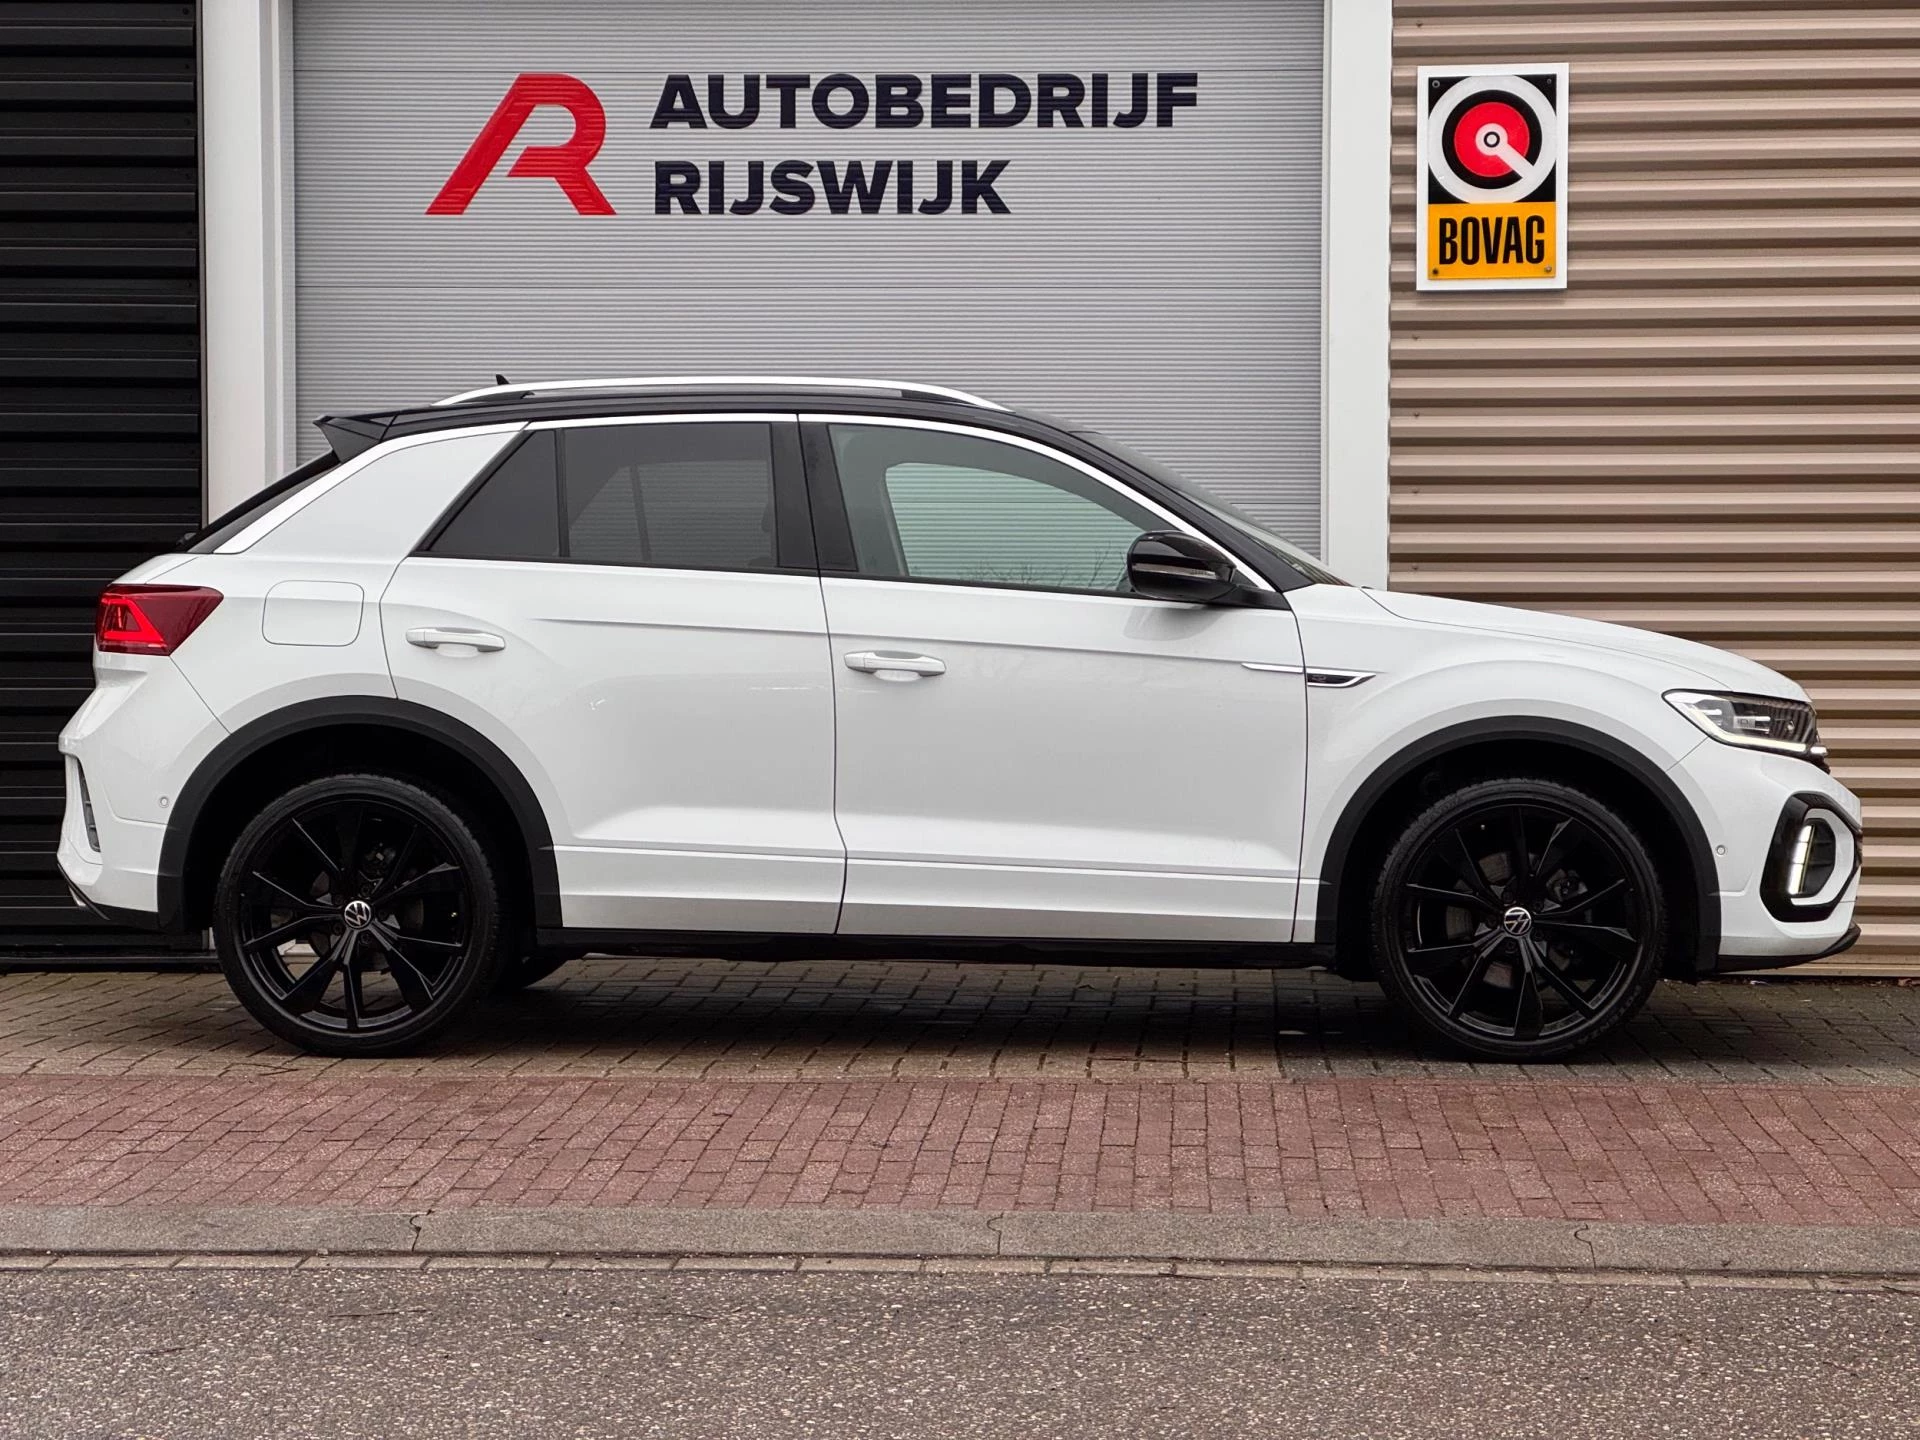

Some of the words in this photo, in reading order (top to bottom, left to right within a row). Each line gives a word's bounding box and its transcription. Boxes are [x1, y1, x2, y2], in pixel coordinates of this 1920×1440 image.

[651, 72, 1198, 130] AUTOBEDRIJF
[655, 159, 1011, 216] RIJSWIJK
[1439, 215, 1545, 265] BOVAG
